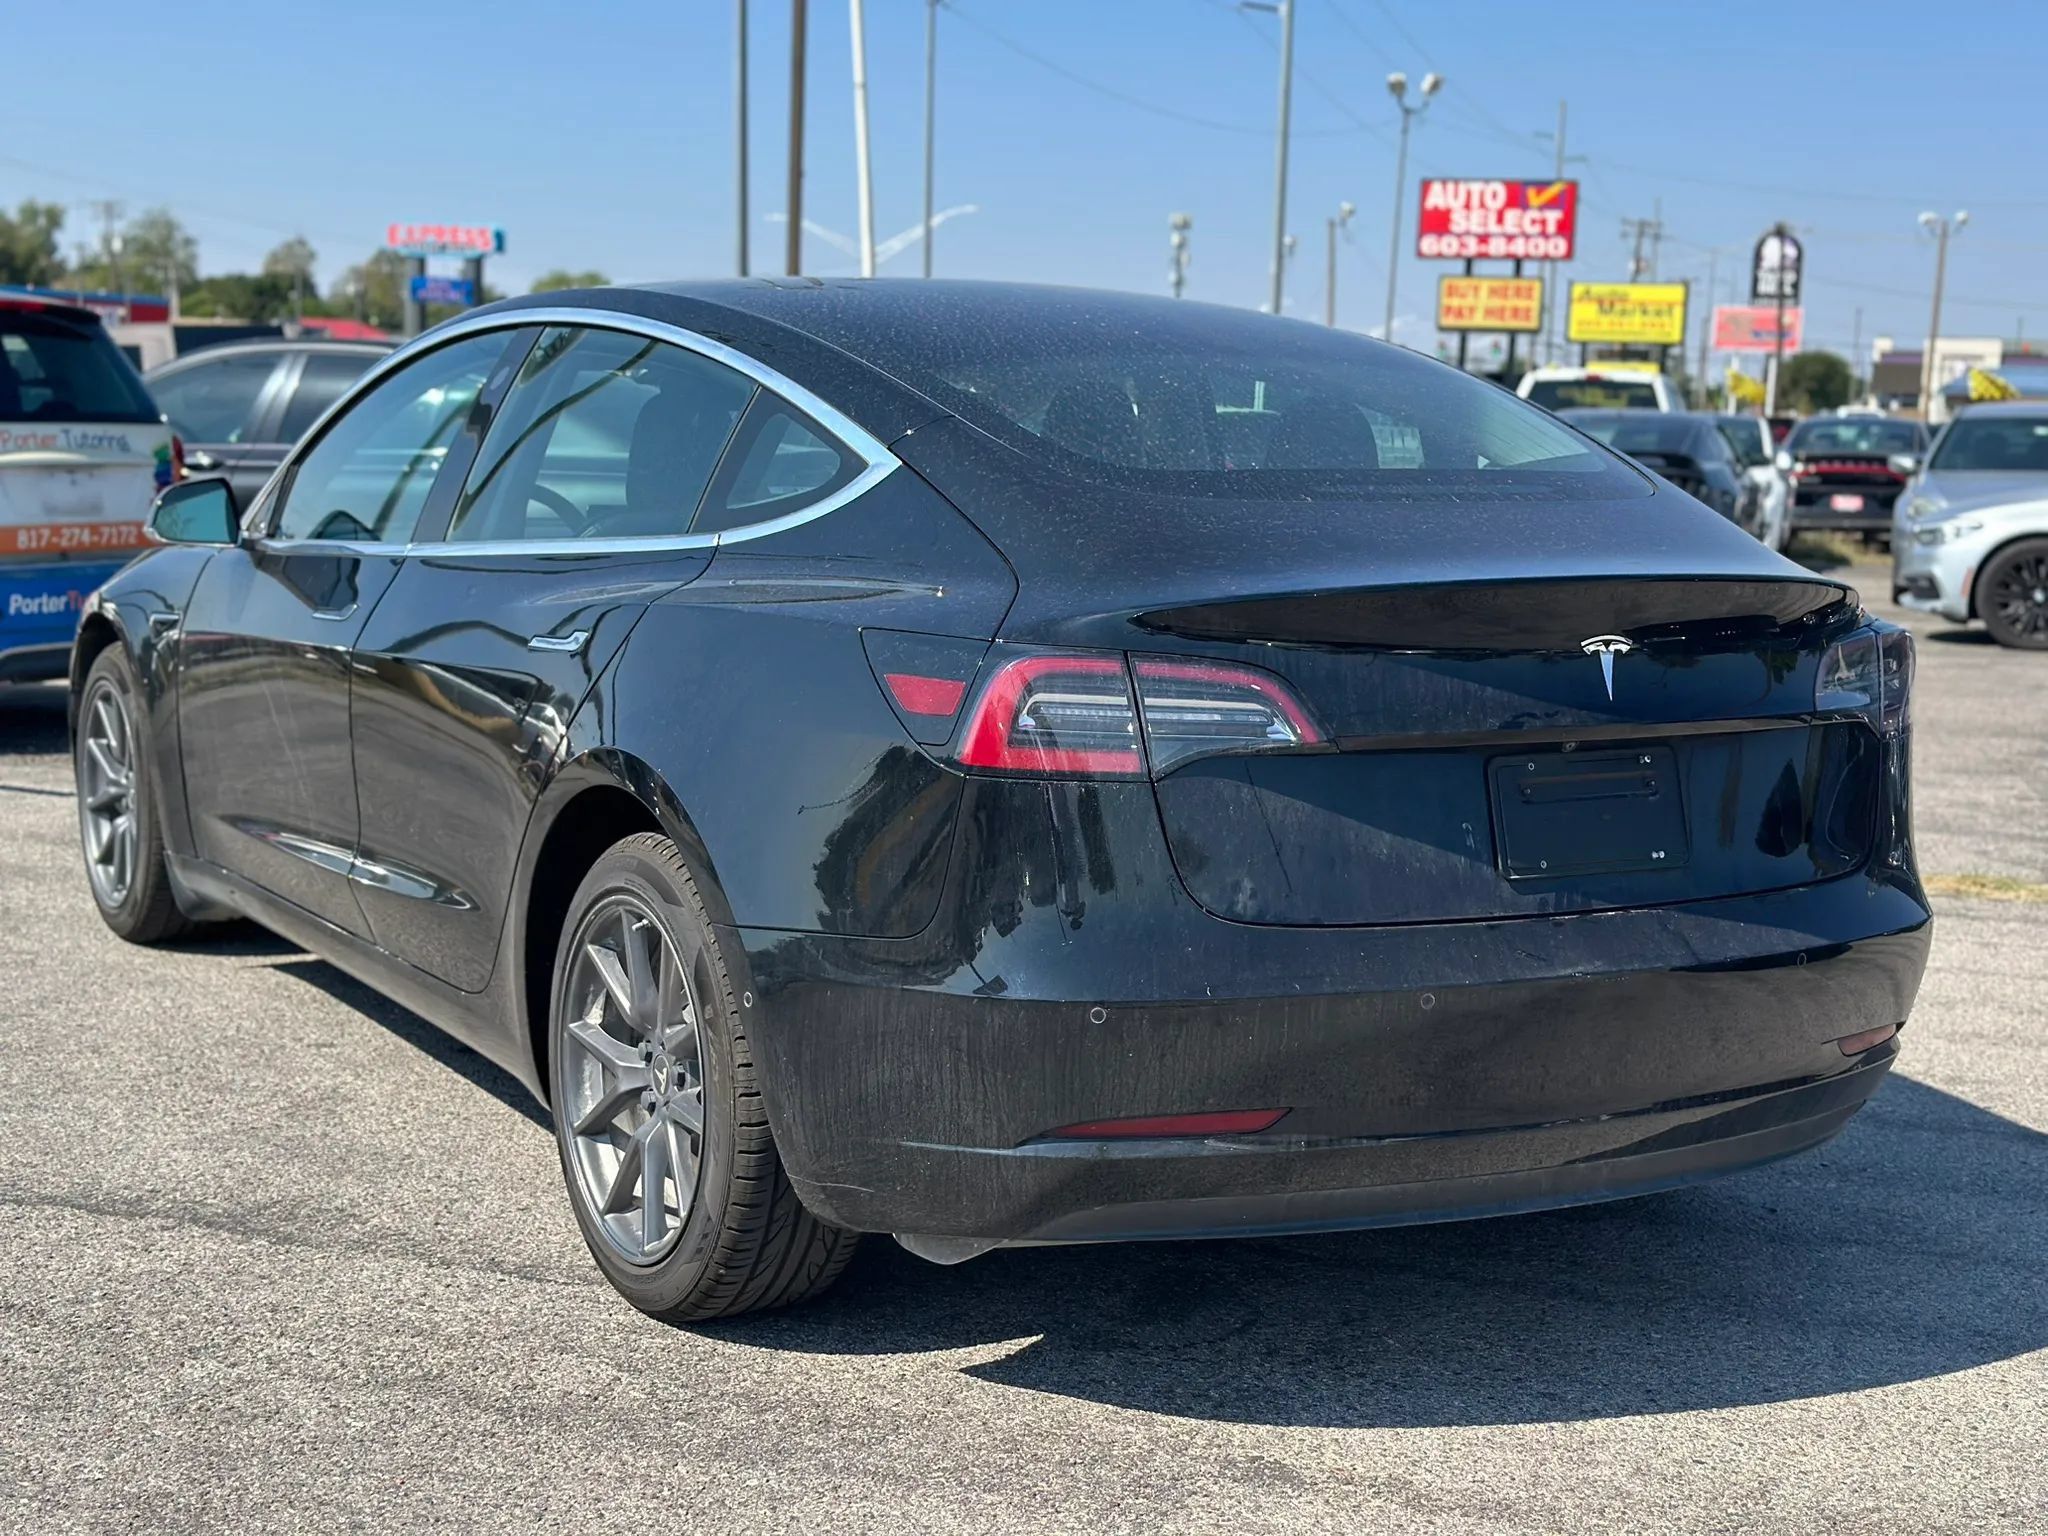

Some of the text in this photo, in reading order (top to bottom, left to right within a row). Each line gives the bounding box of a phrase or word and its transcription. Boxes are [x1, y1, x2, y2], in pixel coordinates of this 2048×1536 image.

[1425, 180, 1507, 211] AUTO
[1449, 208, 1563, 235] SELECT
[1420, 233, 1568, 258] 603-8400
[1445, 283, 1535, 301] BUY HERE
[1443, 305, 1532, 322] PAY HERE
[1597, 299, 1675, 318] Market
[0, 430, 57, 449] Porter
[16, 525, 138, 549] 817-274-7172
